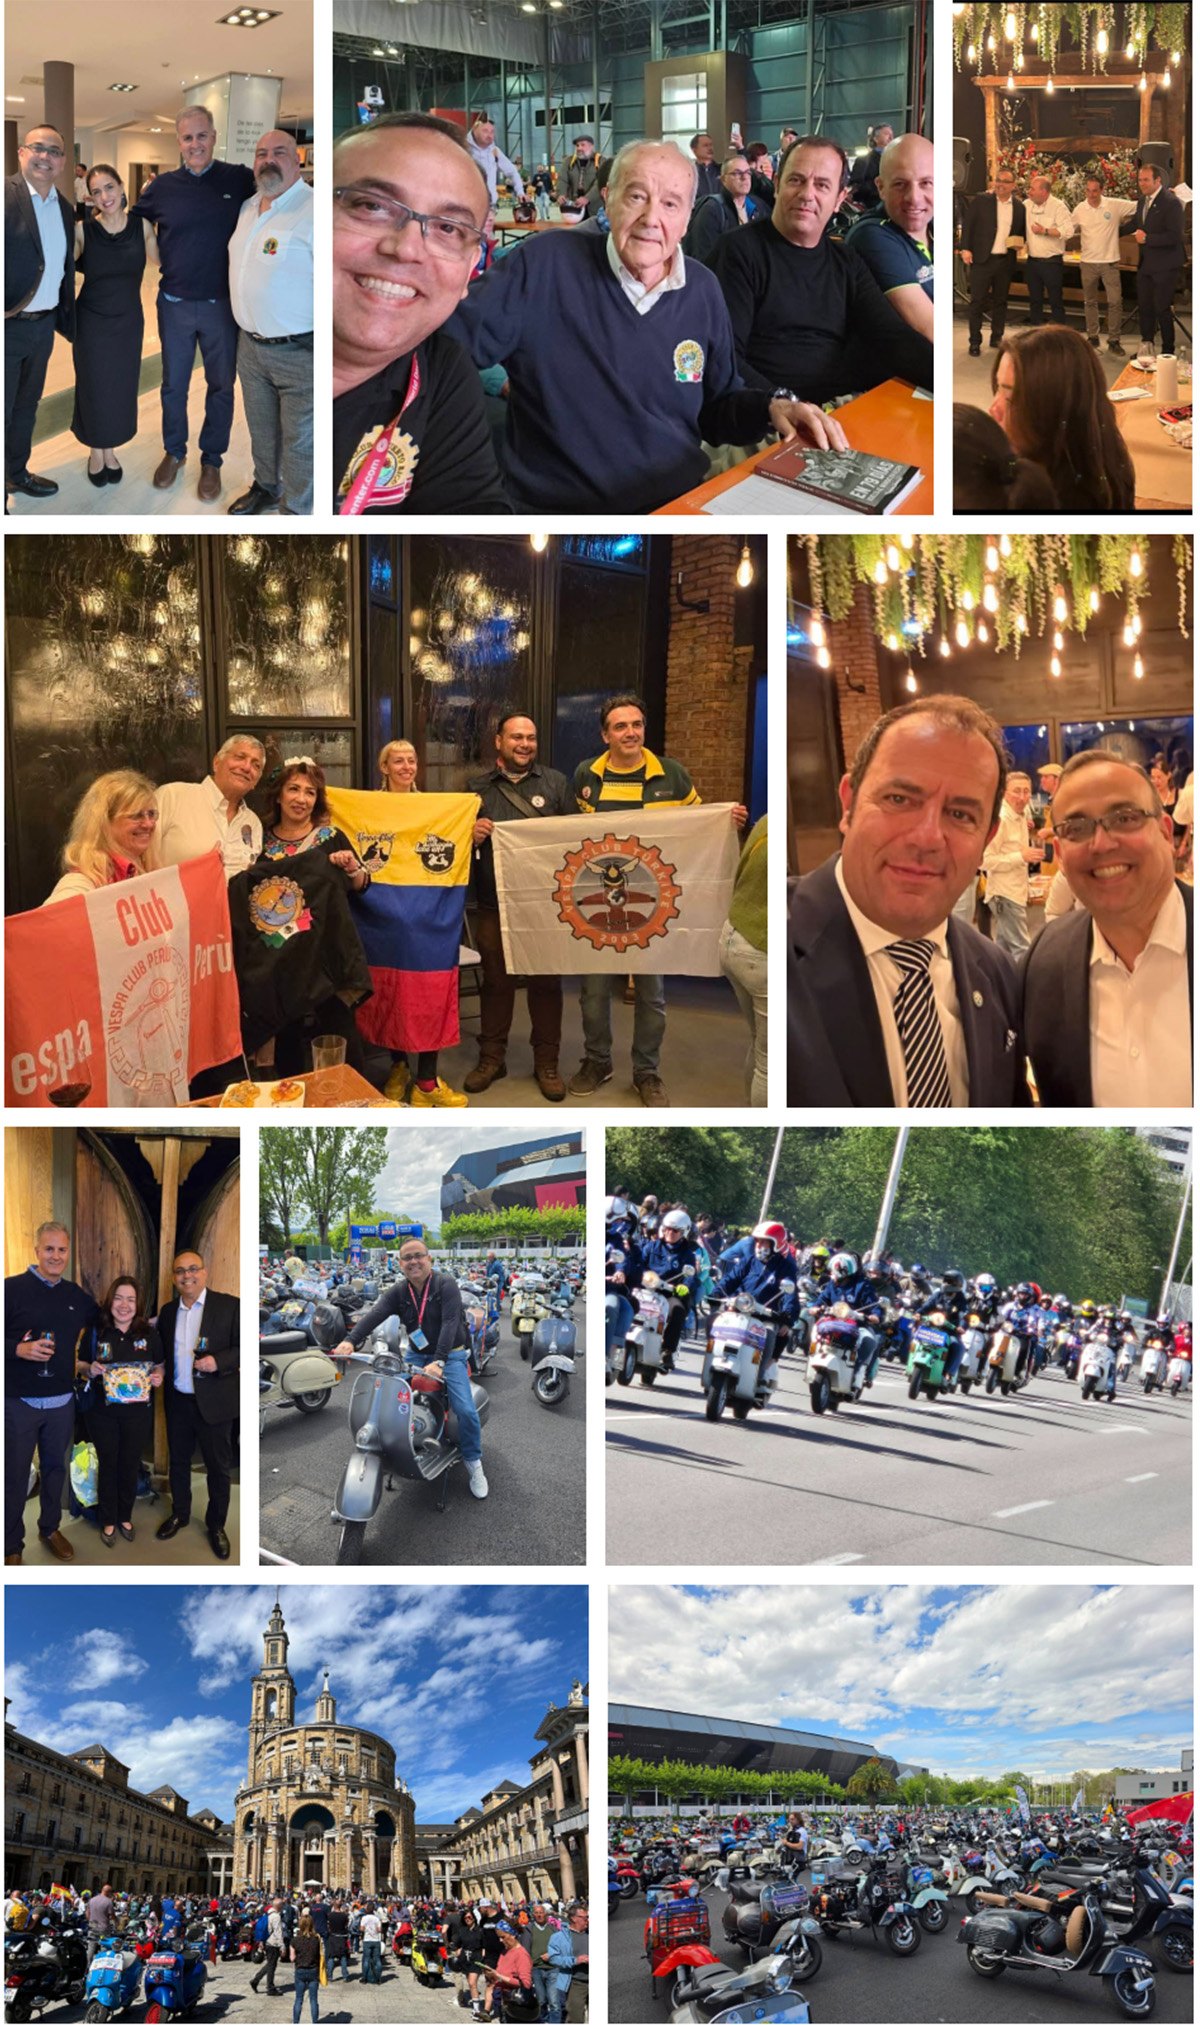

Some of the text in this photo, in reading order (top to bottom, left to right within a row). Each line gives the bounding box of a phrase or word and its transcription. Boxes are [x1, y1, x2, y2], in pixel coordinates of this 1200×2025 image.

[348, 458, 381, 515] enter.com
[861, 469, 881, 490] 79
[581, 843, 621, 860] CLUB
[116, 888, 174, 947] Club
[600, 932, 640, 943] 2003
[108, 992, 129, 1035] VESPA
[122, 960, 147, 993] CLUB
[11, 1019, 93, 1096] espa
